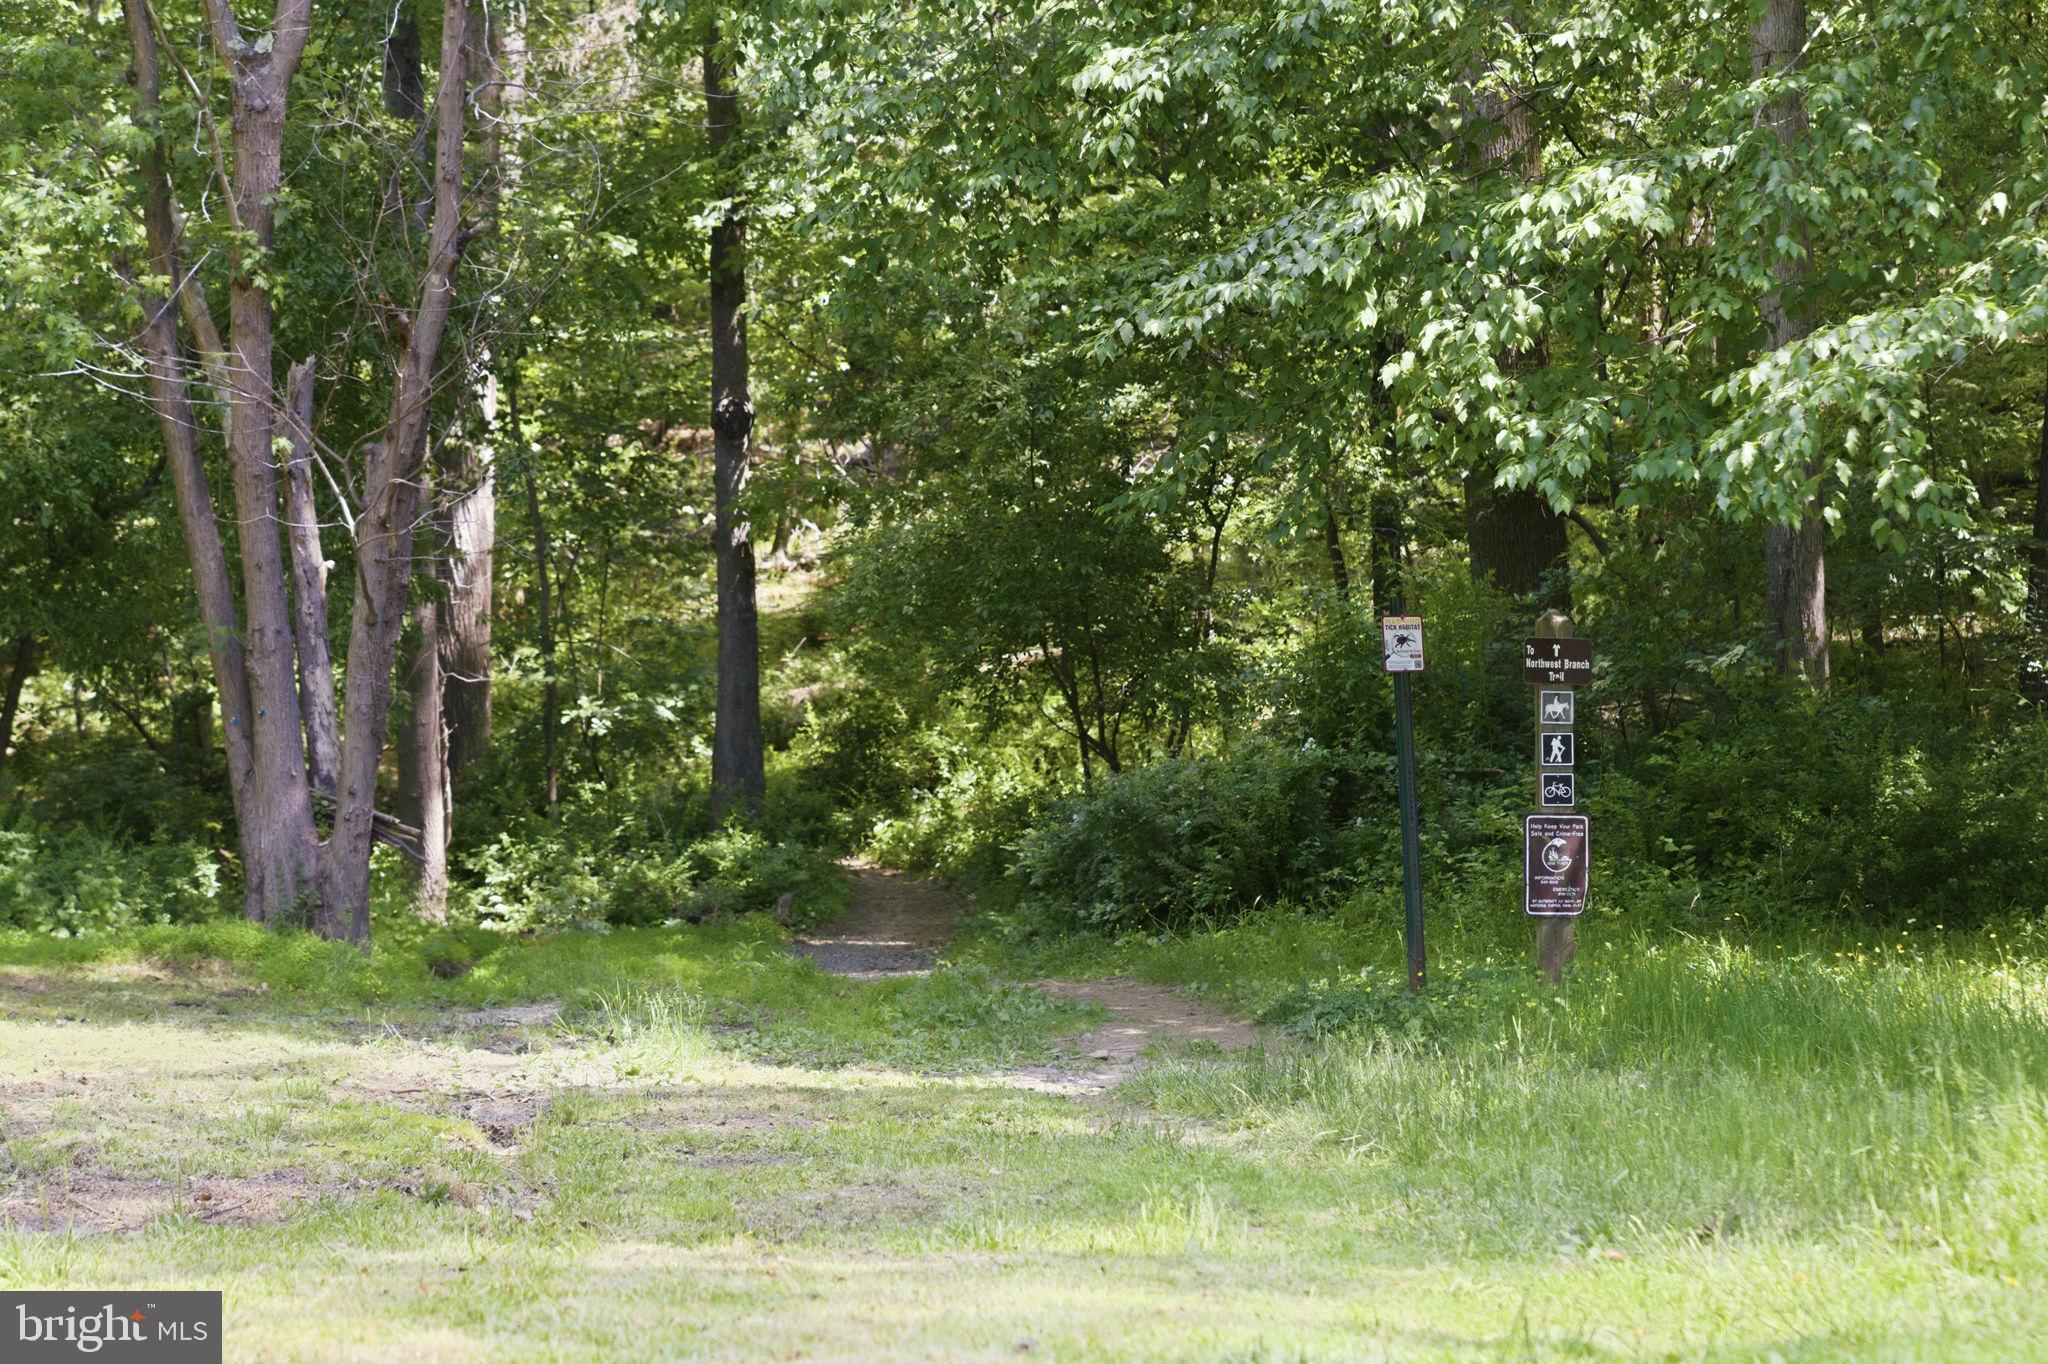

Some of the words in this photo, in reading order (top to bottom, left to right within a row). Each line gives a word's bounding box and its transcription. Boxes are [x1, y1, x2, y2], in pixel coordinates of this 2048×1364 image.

[1526, 644, 1535, 655] To
[1526, 658, 1561, 668] Northwest
[1564, 659, 1589, 669] Branch
[1549, 671, 1564, 681] Trail
